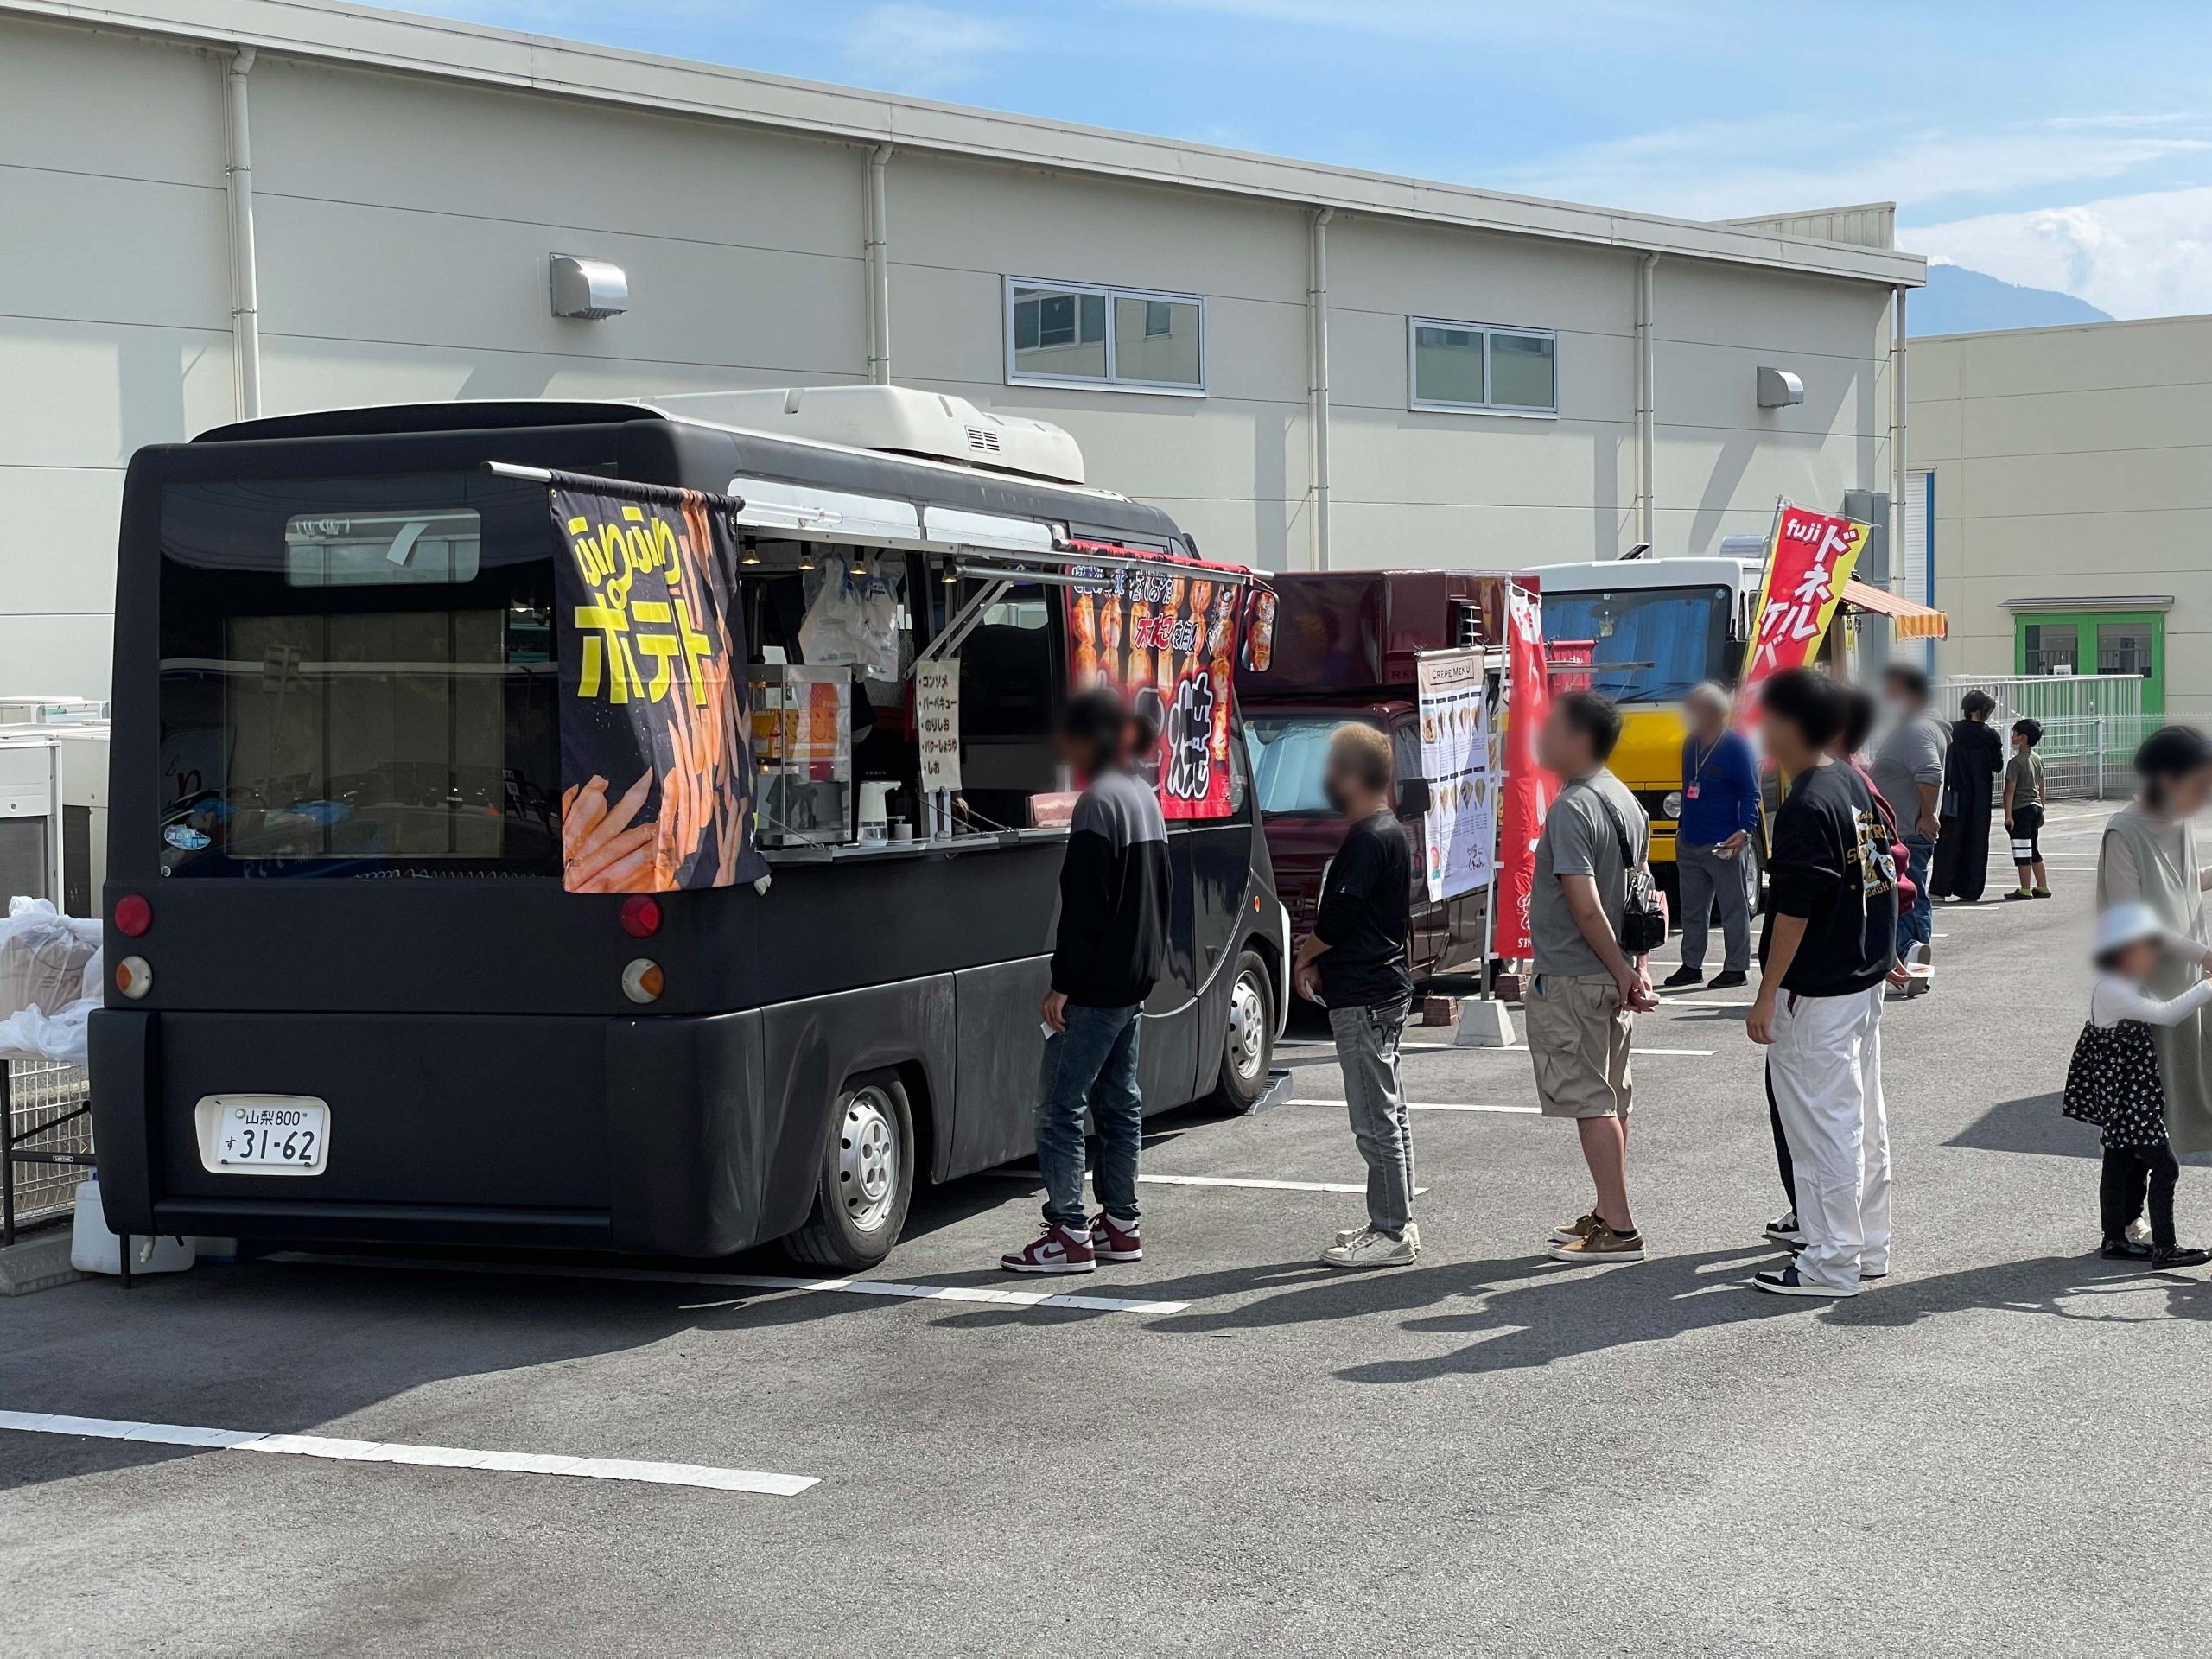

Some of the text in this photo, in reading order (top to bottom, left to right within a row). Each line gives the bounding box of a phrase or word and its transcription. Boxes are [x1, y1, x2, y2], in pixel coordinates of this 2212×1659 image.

[1786, 518, 1822, 543] fuji
[574, 579, 711, 705] ポテト
[1432, 664, 1471, 679] CREPE MENU
[922, 675, 948, 688] コンソメ
[925, 717, 950, 732] のりしお
[927, 760, 940, 774] しお
[226, 1128, 315, 1160] す 31-62
